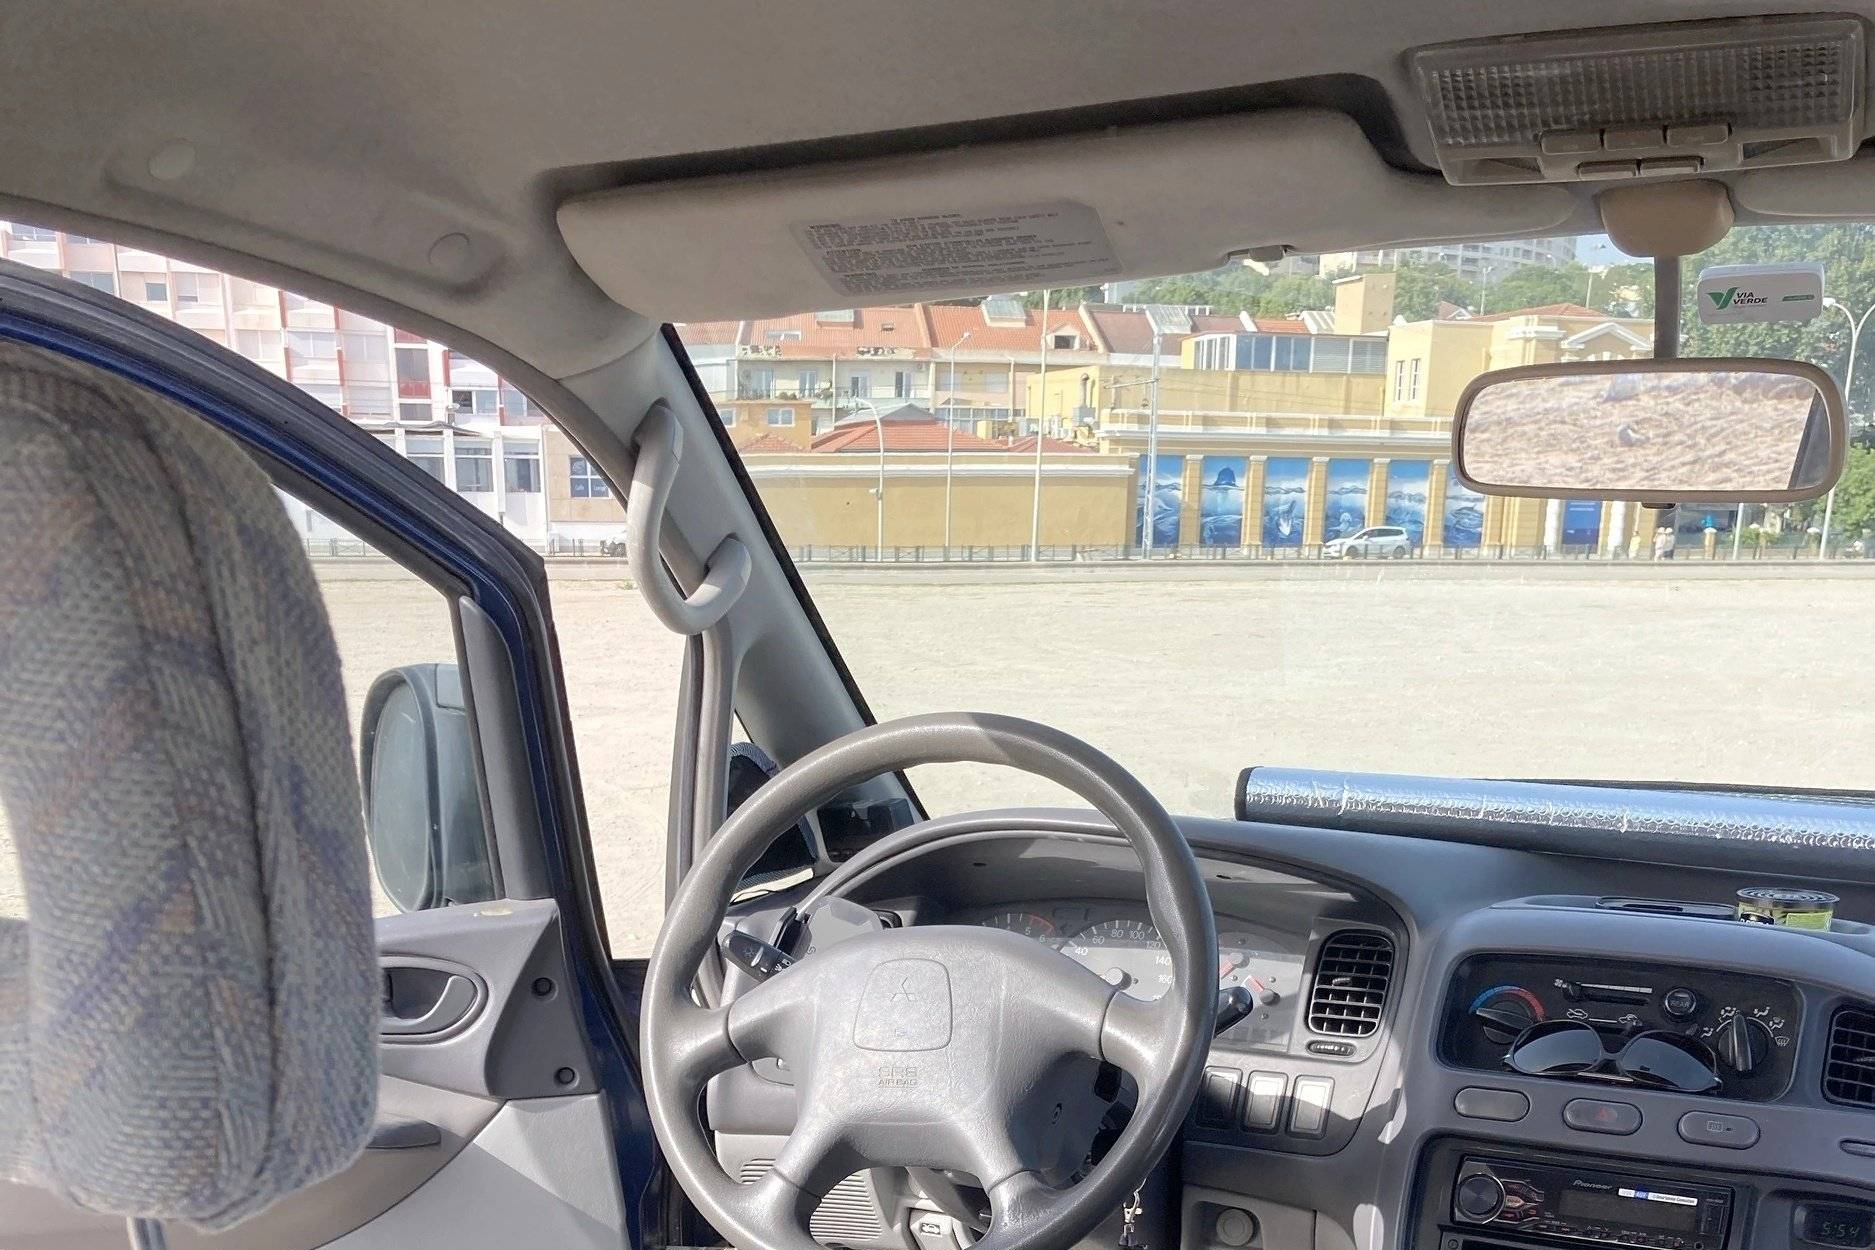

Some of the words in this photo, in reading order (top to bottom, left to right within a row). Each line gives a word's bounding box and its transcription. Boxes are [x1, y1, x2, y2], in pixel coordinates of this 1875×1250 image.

[1737, 291, 1754, 299] VIA
[1733, 297, 1768, 305] VERDE
[1111, 929, 1124, 938] 80
[1129, 930, 1145, 940] 100
[1092, 935, 1105, 944] 60
[1075, 946, 1089, 956] 40
[1156, 955, 1172, 966] 140
[1572, 1179, 1613, 1190] Pioneer
